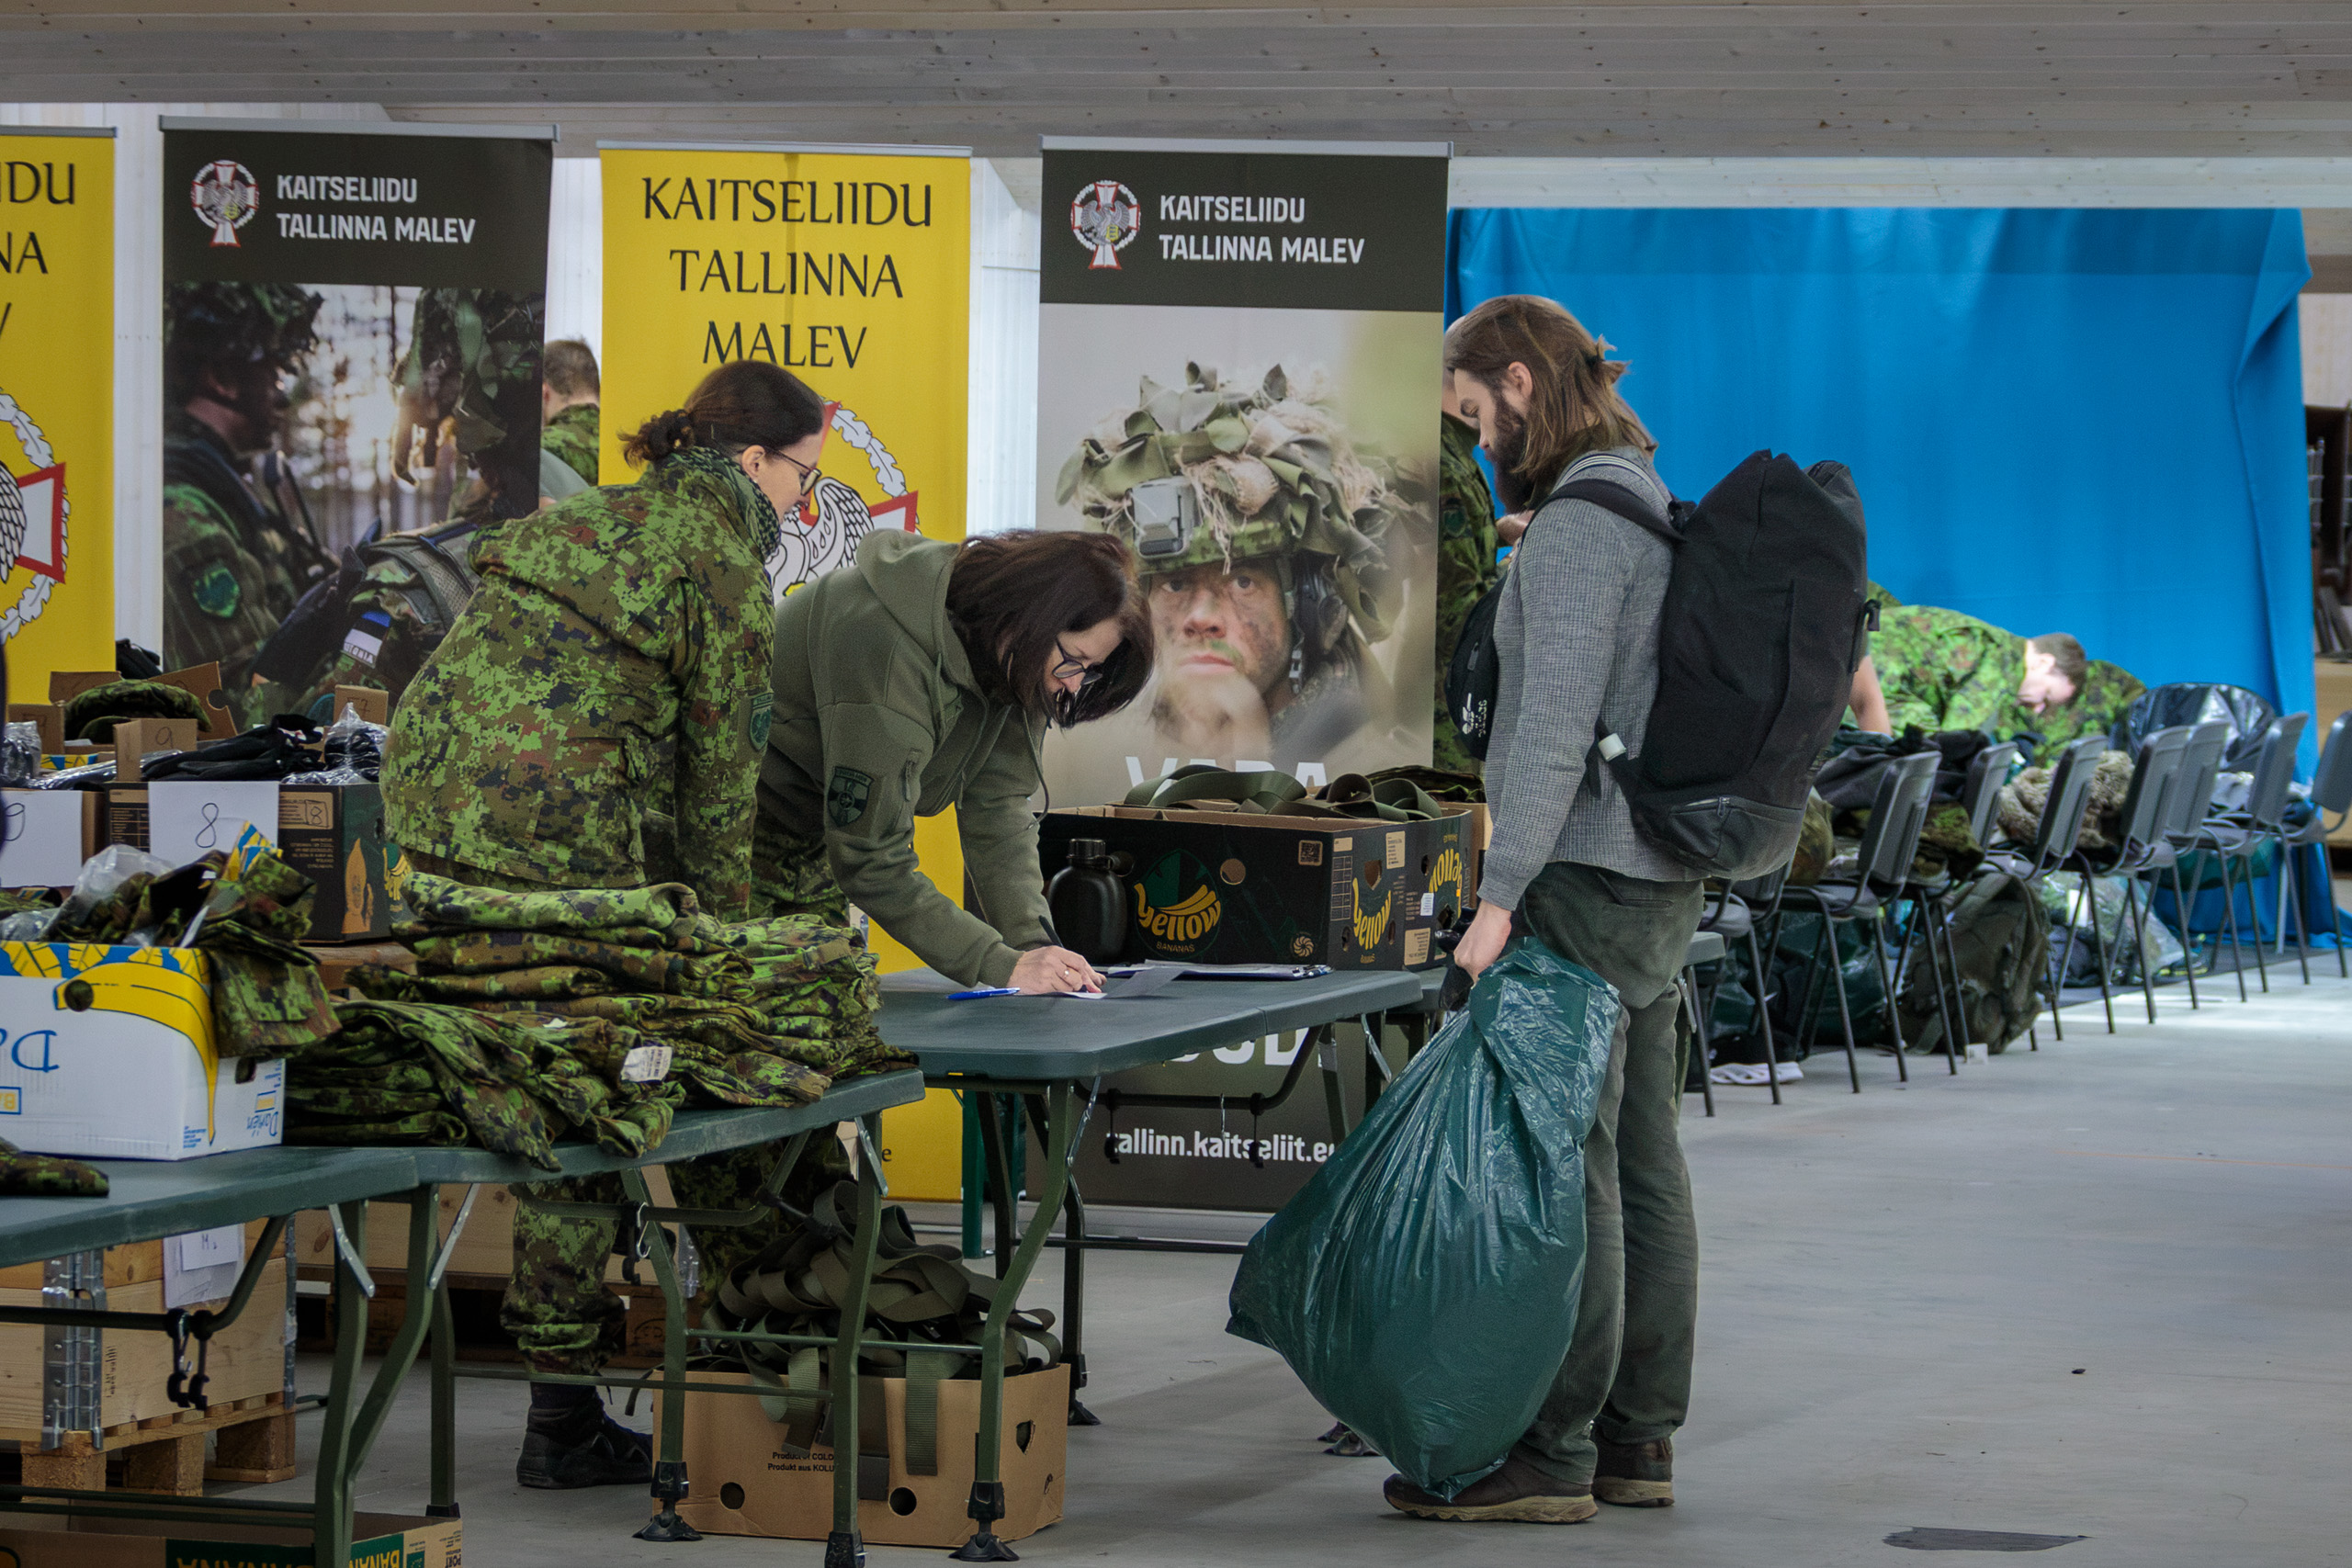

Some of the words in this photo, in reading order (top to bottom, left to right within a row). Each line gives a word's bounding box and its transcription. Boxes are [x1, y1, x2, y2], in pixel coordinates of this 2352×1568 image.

[0, 160, 75, 205] DU
[277, 175, 417, 203] KAITSELIIDU
[641, 176, 932, 227] KAITSELIIDU
[276, 213, 388, 241] TALLINNA
[395, 216, 476, 243] MALEV
[1159, 195, 1306, 223] KAITSELIIDU
[1159, 233, 1273, 262] TALLINNA
[1281, 236, 1365, 264] MALEV
[669, 249, 904, 299] TALLINNA
[703, 320, 867, 369] MALEV
[195, 802, 220, 849] 8
[1133, 882, 1221, 942] yellow
[1352, 877, 1391, 951] yellow
[1157, 941, 1195, 953] BANANAS
[767, 1462, 797, 1471] Produkt
